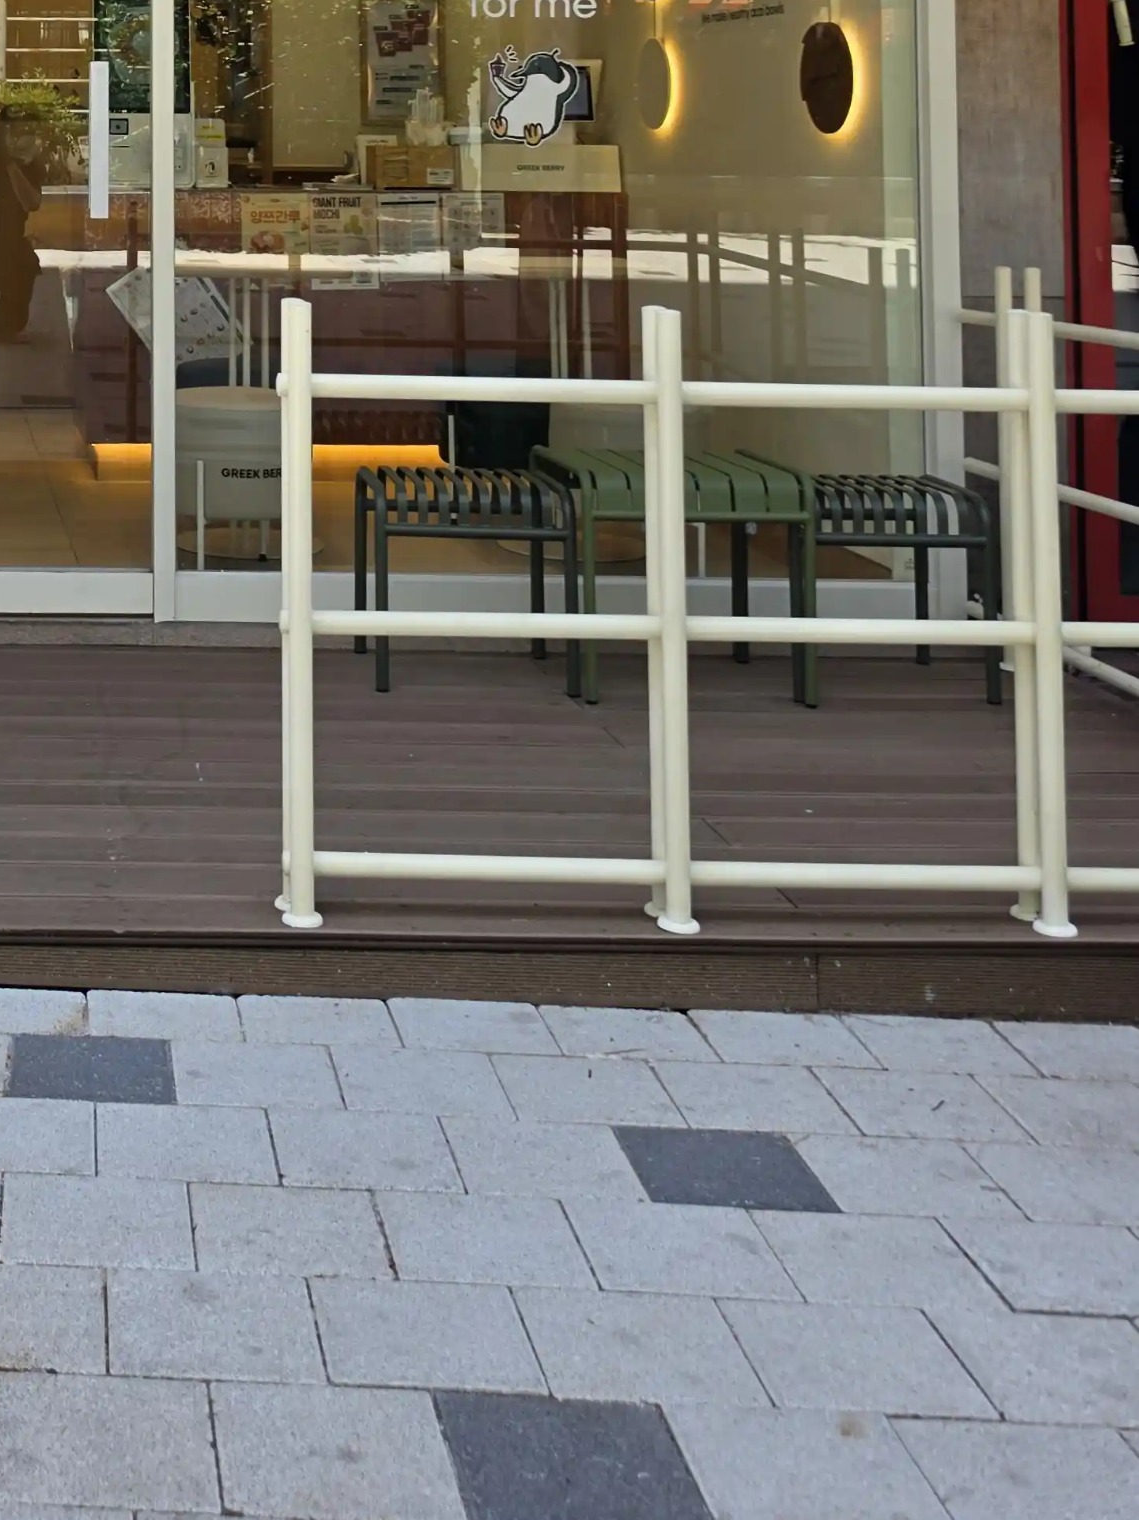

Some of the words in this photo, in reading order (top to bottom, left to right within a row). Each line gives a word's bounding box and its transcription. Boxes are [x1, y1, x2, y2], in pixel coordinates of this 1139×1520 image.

[312, 197, 337, 208] GIANT
[338, 196, 362, 208] FRUIT
[221, 467, 261, 479] GREEK
[262, 467, 282, 479] BER
